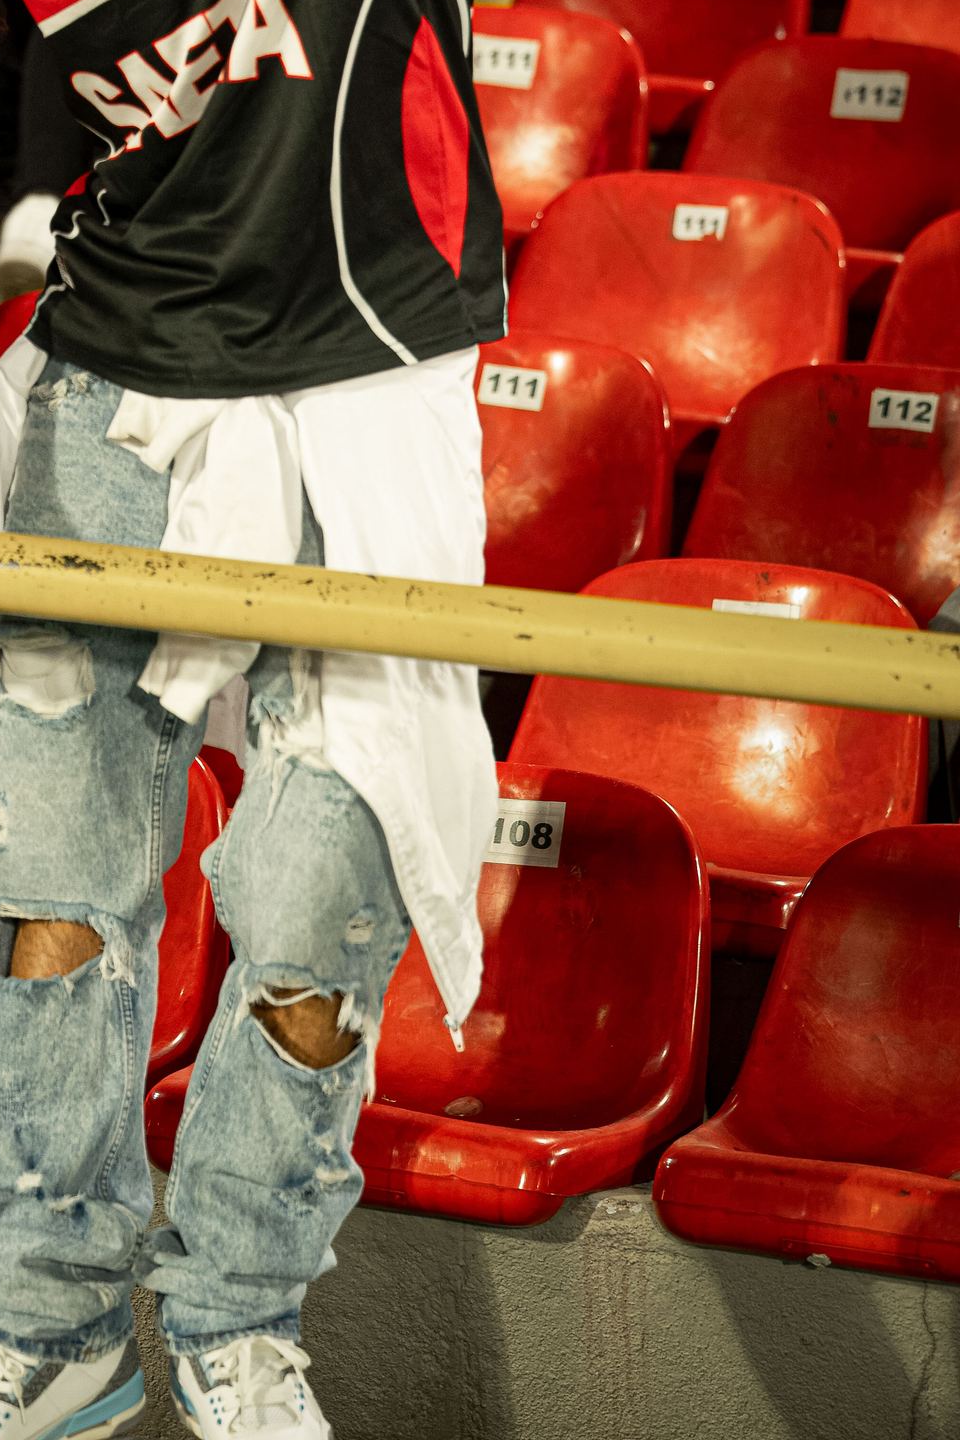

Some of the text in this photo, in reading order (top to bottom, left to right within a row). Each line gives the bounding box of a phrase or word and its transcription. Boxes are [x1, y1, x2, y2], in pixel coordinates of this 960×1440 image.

[488, 373, 538, 399] 111
[877, 396, 932, 423] 112
[492, 817, 554, 850] 108
